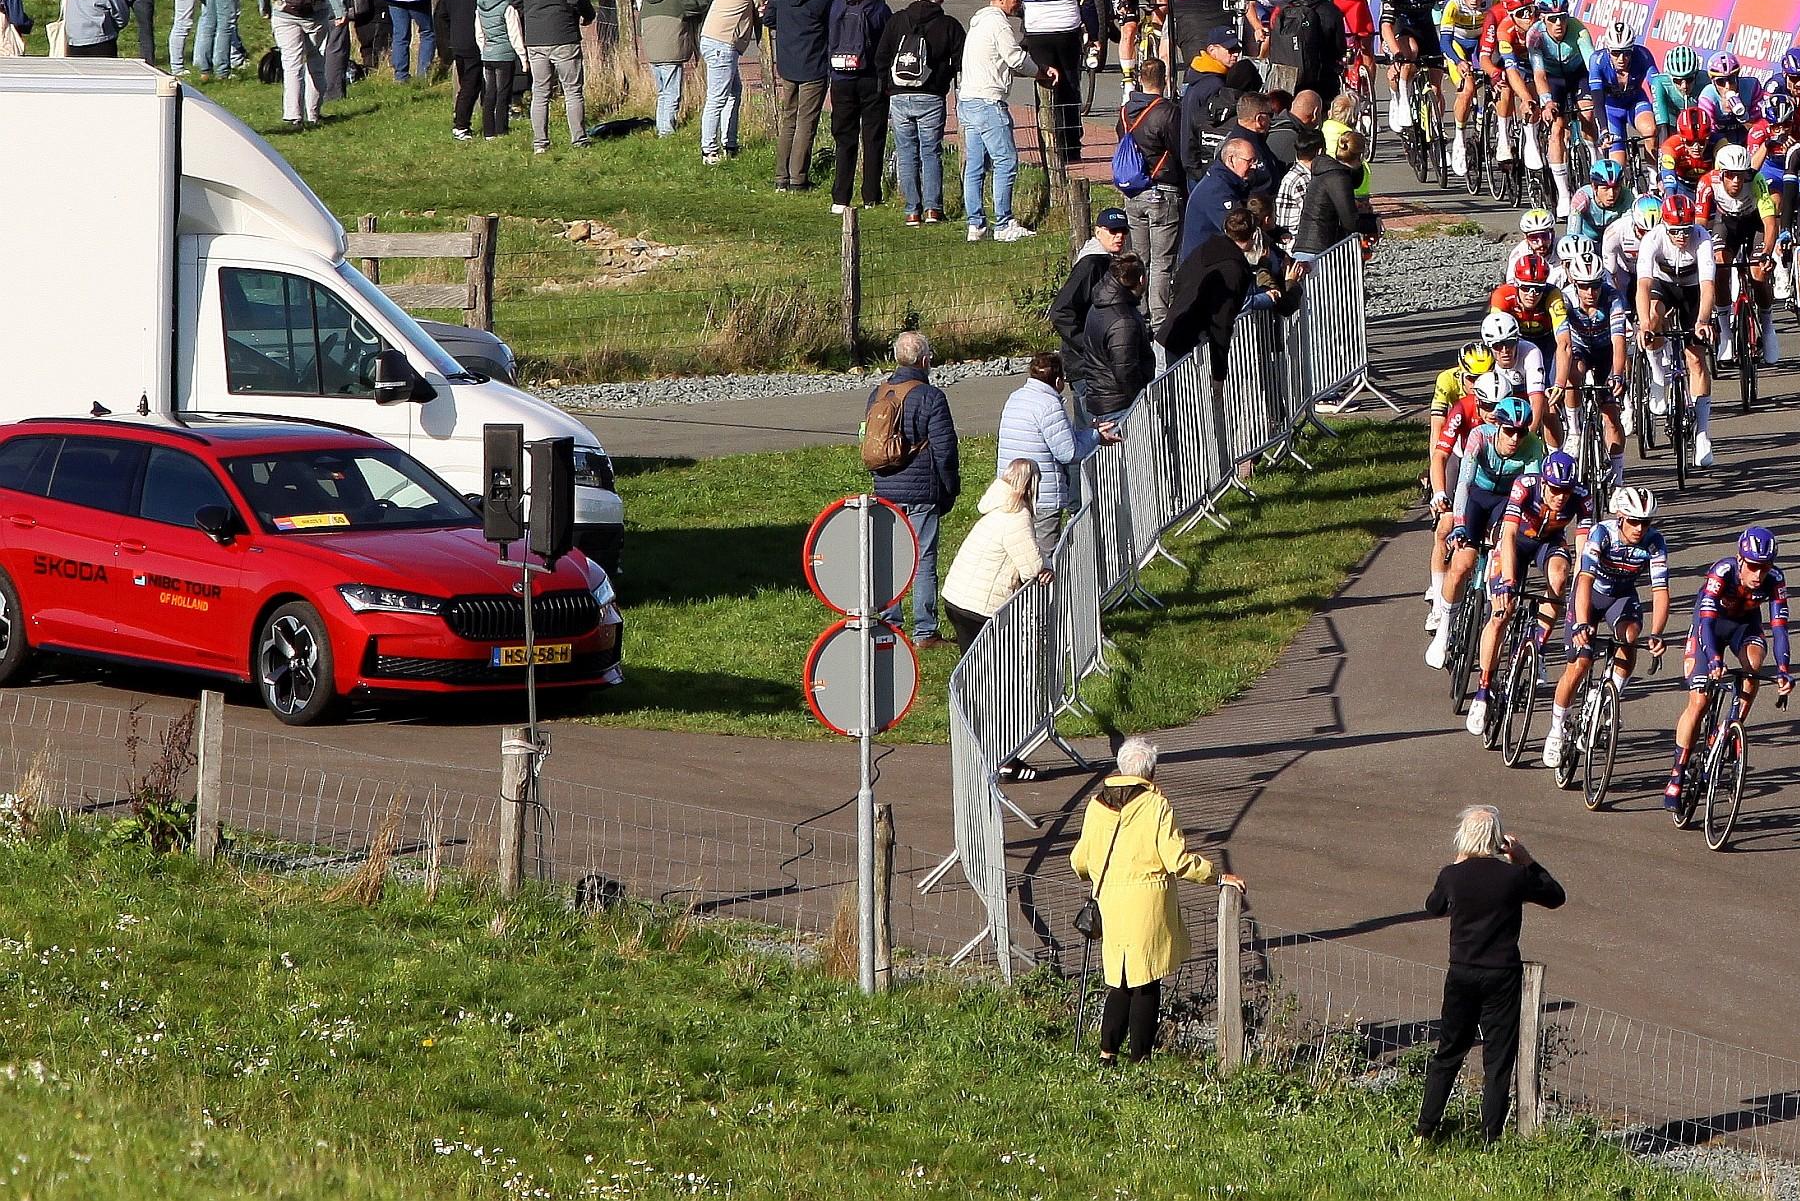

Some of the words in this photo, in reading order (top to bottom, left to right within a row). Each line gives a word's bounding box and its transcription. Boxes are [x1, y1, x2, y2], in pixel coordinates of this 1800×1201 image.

[1660, 9, 1693, 46] NIBC
[1689, 14, 1725, 51] TOUR
[1734, 23, 1771, 61] NIBC
[147, 573, 182, 592] NIBC
[184, 580, 222, 599] TOUR
[160, 591, 171, 604] OF
[171, 594, 209, 612] HOLLAND
